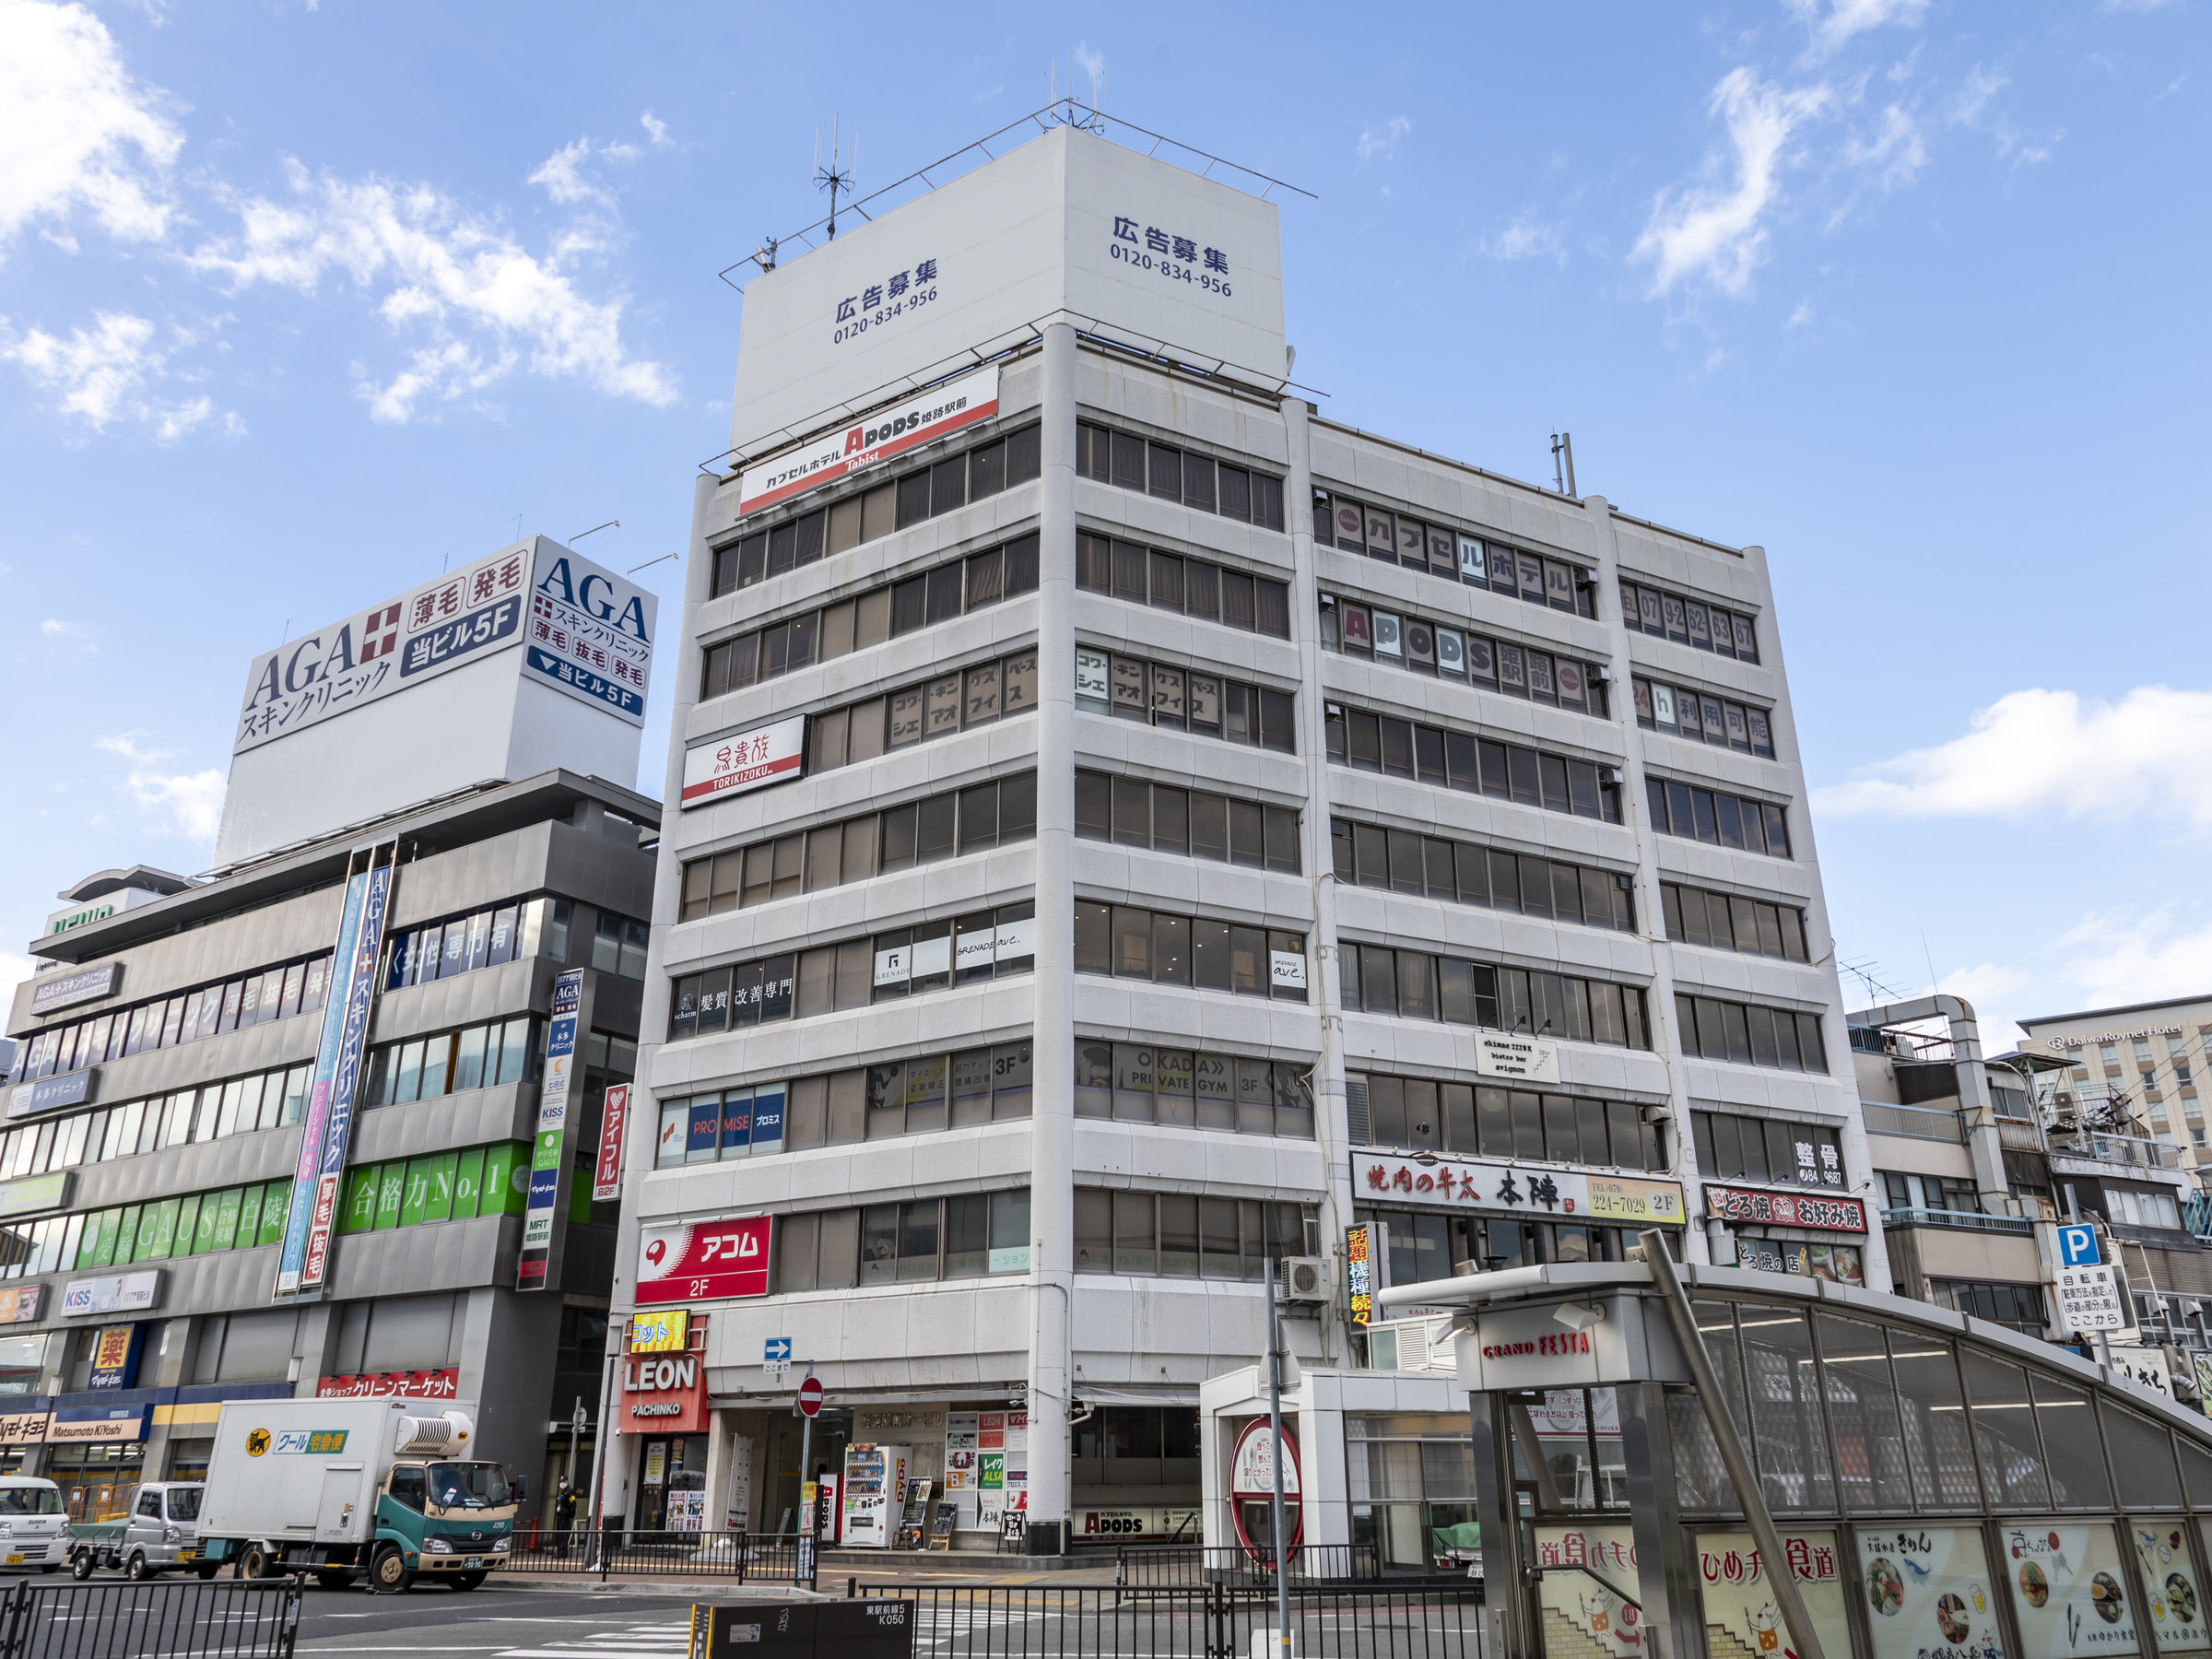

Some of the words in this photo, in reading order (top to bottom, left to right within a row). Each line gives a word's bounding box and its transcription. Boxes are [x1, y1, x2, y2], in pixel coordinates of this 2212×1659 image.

[1112, 216, 1229, 276] 広告募集
[1111, 243, 1231, 298] 0120-834-956
[836, 257, 937, 324] 広告募集
[834, 285, 937, 345] 0120-834-956
[767, 450, 841, 488] カプセルホテル
[921, 396, 967, 425] 姫路駅前
[845, 451, 879, 472] Tabist
[1369, 517, 1568, 592] カプセルホテル
[414, 583, 463, 626] 薄毛
[473, 557, 521, 603] 発毛
[537, 558, 651, 643] AGA
[408, 609, 512, 670] 当ビル5F
[555, 607, 649, 664] スキンクリニック
[245, 623, 356, 712] AGA
[535, 621, 569, 650] 薄毛
[575, 640, 606, 668] 抜毛
[615, 659, 644, 687] 発毛
[558, 661, 633, 708] 当ビル5F
[237, 660, 390, 744] スキンクリニック
[714, 735, 770, 774] 鳥貴族
[712, 765, 768, 790] TORIKIZOKU
[361, 872, 385, 947] AGA
[957, 941, 995, 956] GRENADE
[37, 985, 53, 1001] AGA
[61, 968, 112, 993] スキンクリニック
[876, 968, 911, 980] GRENADE
[556, 985, 579, 1000] AGA
[700, 978, 793, 1012] 髪質改善専門
[549, 1041, 573, 1052] クリニック
[2067, 1035, 2102, 1047] Daiwa
[2104, 1030, 2147, 1043] Roynet
[2147, 1023, 2183, 1036] Hotel
[11, 1042, 56, 1074] AGA
[995, 1056, 1016, 1076] 3F
[1495, 1065, 1525, 1074] avignon
[324, 979, 370, 1169] スキンクリニック
[1132, 1071, 1189, 1089] PRIVATE
[1198, 1078, 1228, 1093] GYM
[1241, 1077, 1259, 1093] 3F
[542, 1106, 563, 1119] KISS
[693, 1114, 749, 1135] PROMISE
[756, 1113, 780, 1126] プロミス
[601, 1111, 623, 1181] アイフル
[1794, 1142, 1838, 1170] 整骨
[317, 1181, 335, 1222] 薄毛
[597, 1186, 615, 1197] B2F
[1368, 1164, 1481, 1200] 焼肉の牛太
[1496, 1170, 1559, 1211] 本陣
[241, 1196, 282, 1232] 白陵
[1593, 1194, 1646, 1214] 224-7029
[1653, 1194, 1674, 1211] 2F
[1724, 1192, 1771, 1221] どろ焼
[1798, 1200, 1862, 1230] お好み焼
[139, 1205, 216, 1246] GAUS
[529, 1219, 549, 1230] MRT
[308, 1234, 326, 1275] 抜毛
[701, 1232, 759, 1262] アコム
[2066, 1229, 2089, 1262] P
[689, 1279, 710, 1297] 2F
[2063, 1272, 2108, 1286] 自転車
[65, 1289, 91, 1307] KISS
[2070, 1314, 2118, 1327] ここから
[100, 1330, 126, 1366] 薬
[1482, 1342, 1534, 1358] GRAND
[1538, 1332, 1590, 1356] FESTA
[624, 1359, 695, 1392] LEON
[765, 1363, 790, 1372] ここまで
[320, 1386, 353, 1397] 金券ショップ
[352, 1376, 455, 1397] クリーンマーケット
[630, 1403, 681, 1416] PACHINKO
[982, 1417, 1001, 1427] LEON
[53, 1426, 93, 1438] Matsumoto
[93, 1424, 124, 1436] KiYoshi
[277, 1434, 307, 1452] クール
[310, 1432, 345, 1452] 宅急便
[983, 1470, 1003, 1481] ALSA
[984, 1458, 1003, 1470] レイク
[866, 1604, 904, 1615] 東駅前線5
[879, 1615, 904, 1625] K050
